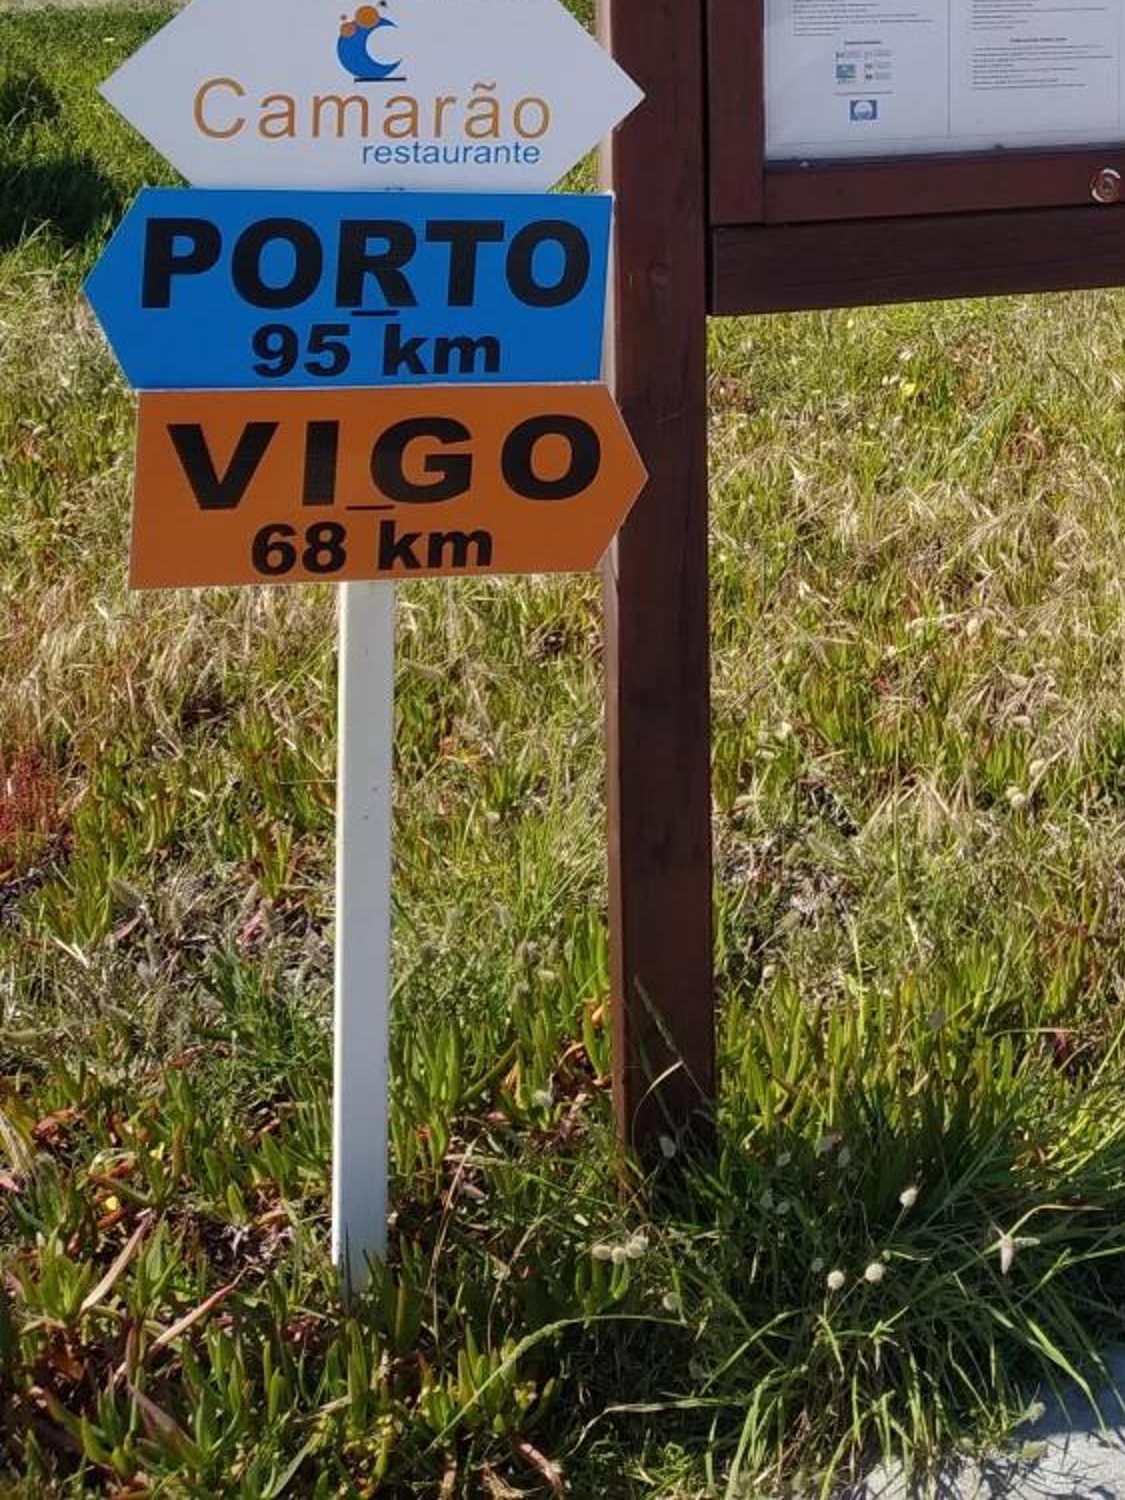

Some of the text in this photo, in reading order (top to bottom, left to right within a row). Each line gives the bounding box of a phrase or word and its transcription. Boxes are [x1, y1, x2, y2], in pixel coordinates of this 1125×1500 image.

[192, 77, 551, 140] Camarão
[361, 141, 541, 166] restaurante
[140, 216, 592, 310] PORTO
[251, 323, 501, 378] 95 km
[167, 413, 601, 511] VIGO
[251, 519, 493, 576] 68 km
